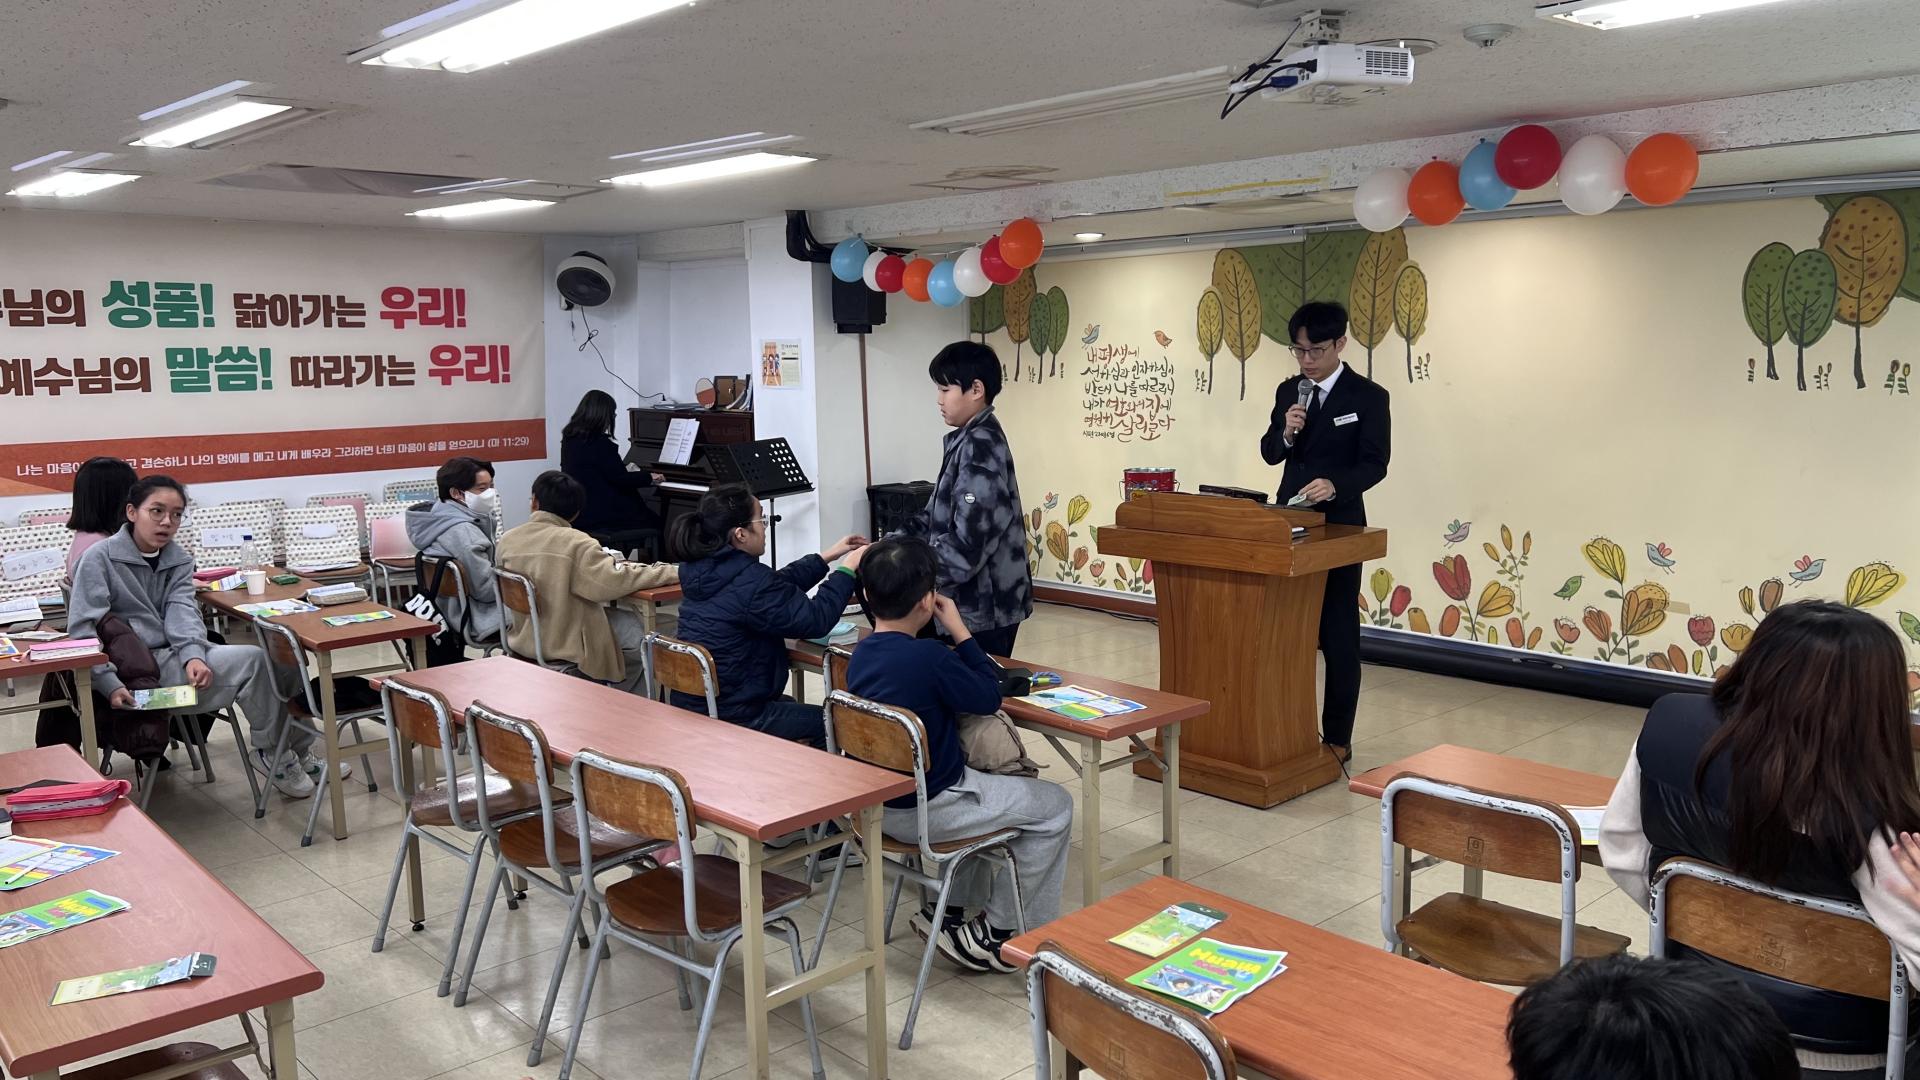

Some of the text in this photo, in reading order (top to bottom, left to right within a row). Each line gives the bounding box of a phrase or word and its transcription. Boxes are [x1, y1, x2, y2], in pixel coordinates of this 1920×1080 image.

[0, 280, 467, 329] 님의 성품! 닮아가는 우리!
[0, 344, 511, 396] 예수님의 말씀! 따라가는 우리!
[1080, 356, 1174, 382] 선하심과 인자하심이
[1084, 377, 1175, 398] 반드시 나를 따르리니
[1083, 397, 1105, 411] 내가
[1084, 412, 1176, 443] 영원히 살리로다
[17, 464, 43, 476] 나는
[141, 456, 187, 469] 겸손하니
[191, 454, 213, 466] 나의
[217, 452, 250, 465] 멍에를
[253, 451, 274, 463] 메고
[277, 449, 298, 461] 내게
[301, 447, 331, 459] 배우라
[335, 446, 373, 458] 그리하면
[376, 445, 395, 456] 너희
[398, 443, 426, 454] 마음이
[449, 439, 484, 451] 얻으리니
[503, 436, 530, 447] 11:29)
[405, 593, 436, 621] DO
